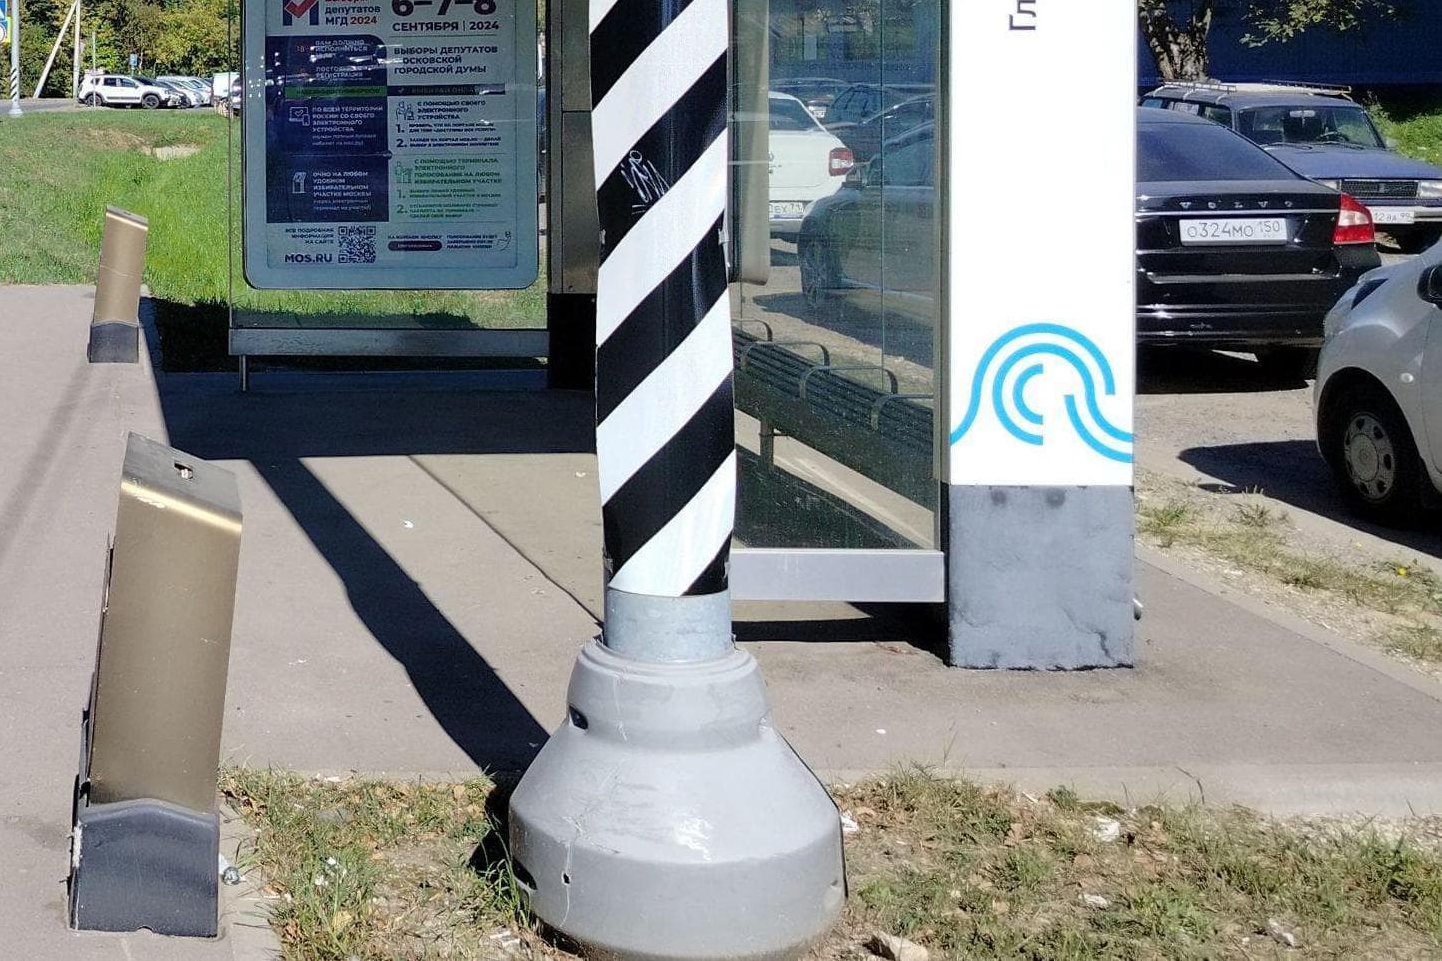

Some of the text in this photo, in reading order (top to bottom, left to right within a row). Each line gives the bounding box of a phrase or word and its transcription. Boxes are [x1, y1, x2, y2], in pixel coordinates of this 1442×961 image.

[324, 5, 381, 15] депутатов
[325, 16, 378, 27] МГД 2024
[392, 20, 500, 32] СЕНТЯБРЯ 2024
[394, 46, 498, 55] ВЫБОРЫ ДЕПУТАТОВ
[398, 55, 462, 64] ОСКОВСКОЙ
[394, 65, 487, 75] ГОРОДСКОЙ ДУМЫ
[1259, 220, 1280, 233] 150
[284, 253, 333, 263] MOS.RU
